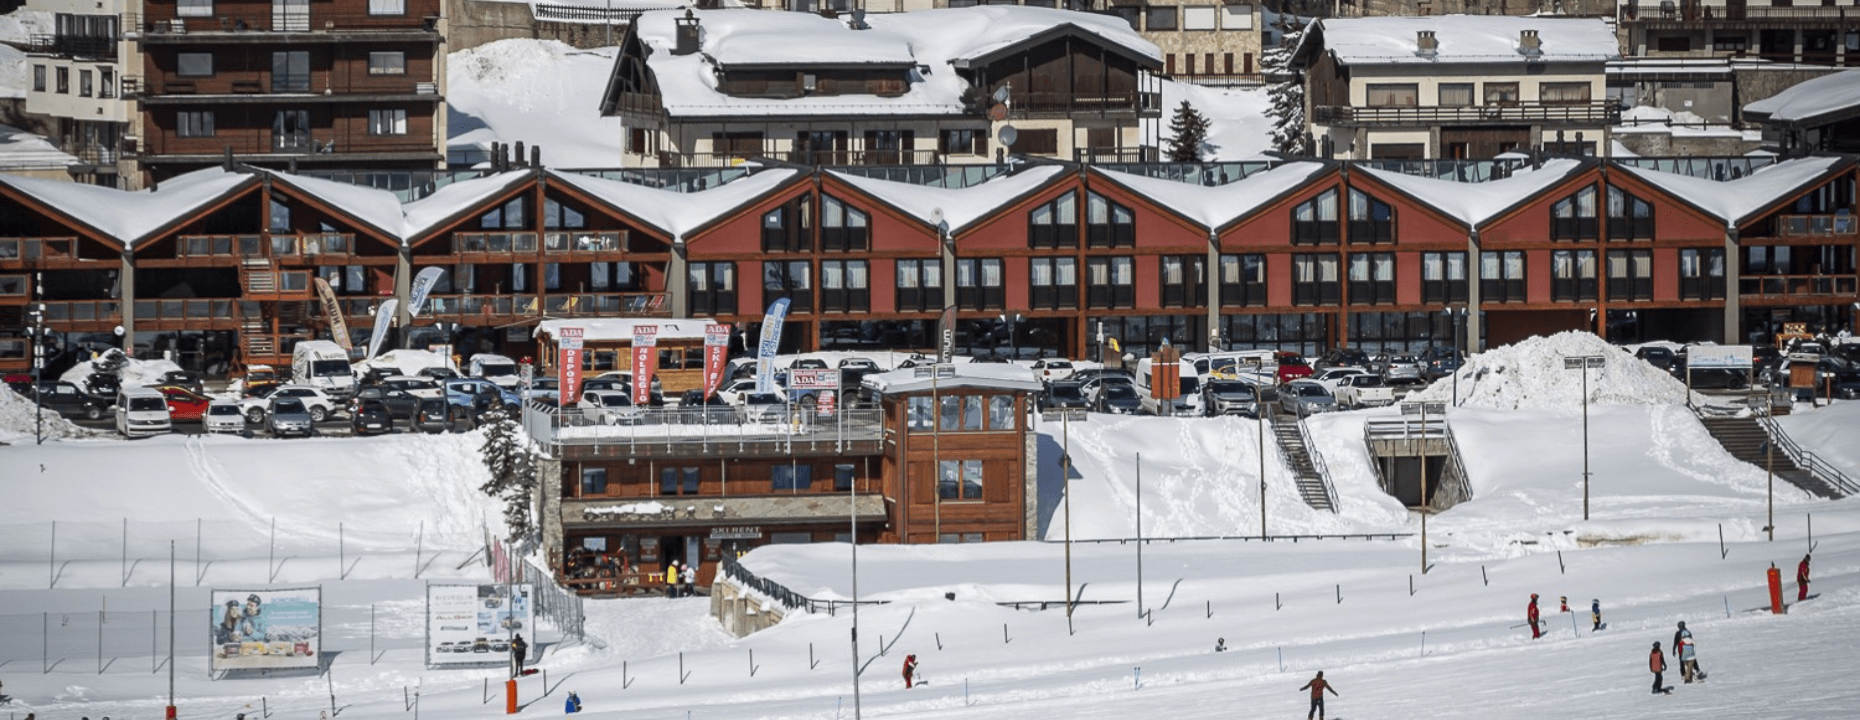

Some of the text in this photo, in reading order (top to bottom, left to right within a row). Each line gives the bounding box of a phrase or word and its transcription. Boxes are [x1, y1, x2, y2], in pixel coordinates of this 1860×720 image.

[562, 329, 583, 337] ADA
[635, 326, 657, 334] ADA
[707, 325, 729, 334] ADA
[712, 347, 720, 369] SKI
[638, 347, 648, 402] NOLEGGIO
[795, 375, 815, 385] ADA
